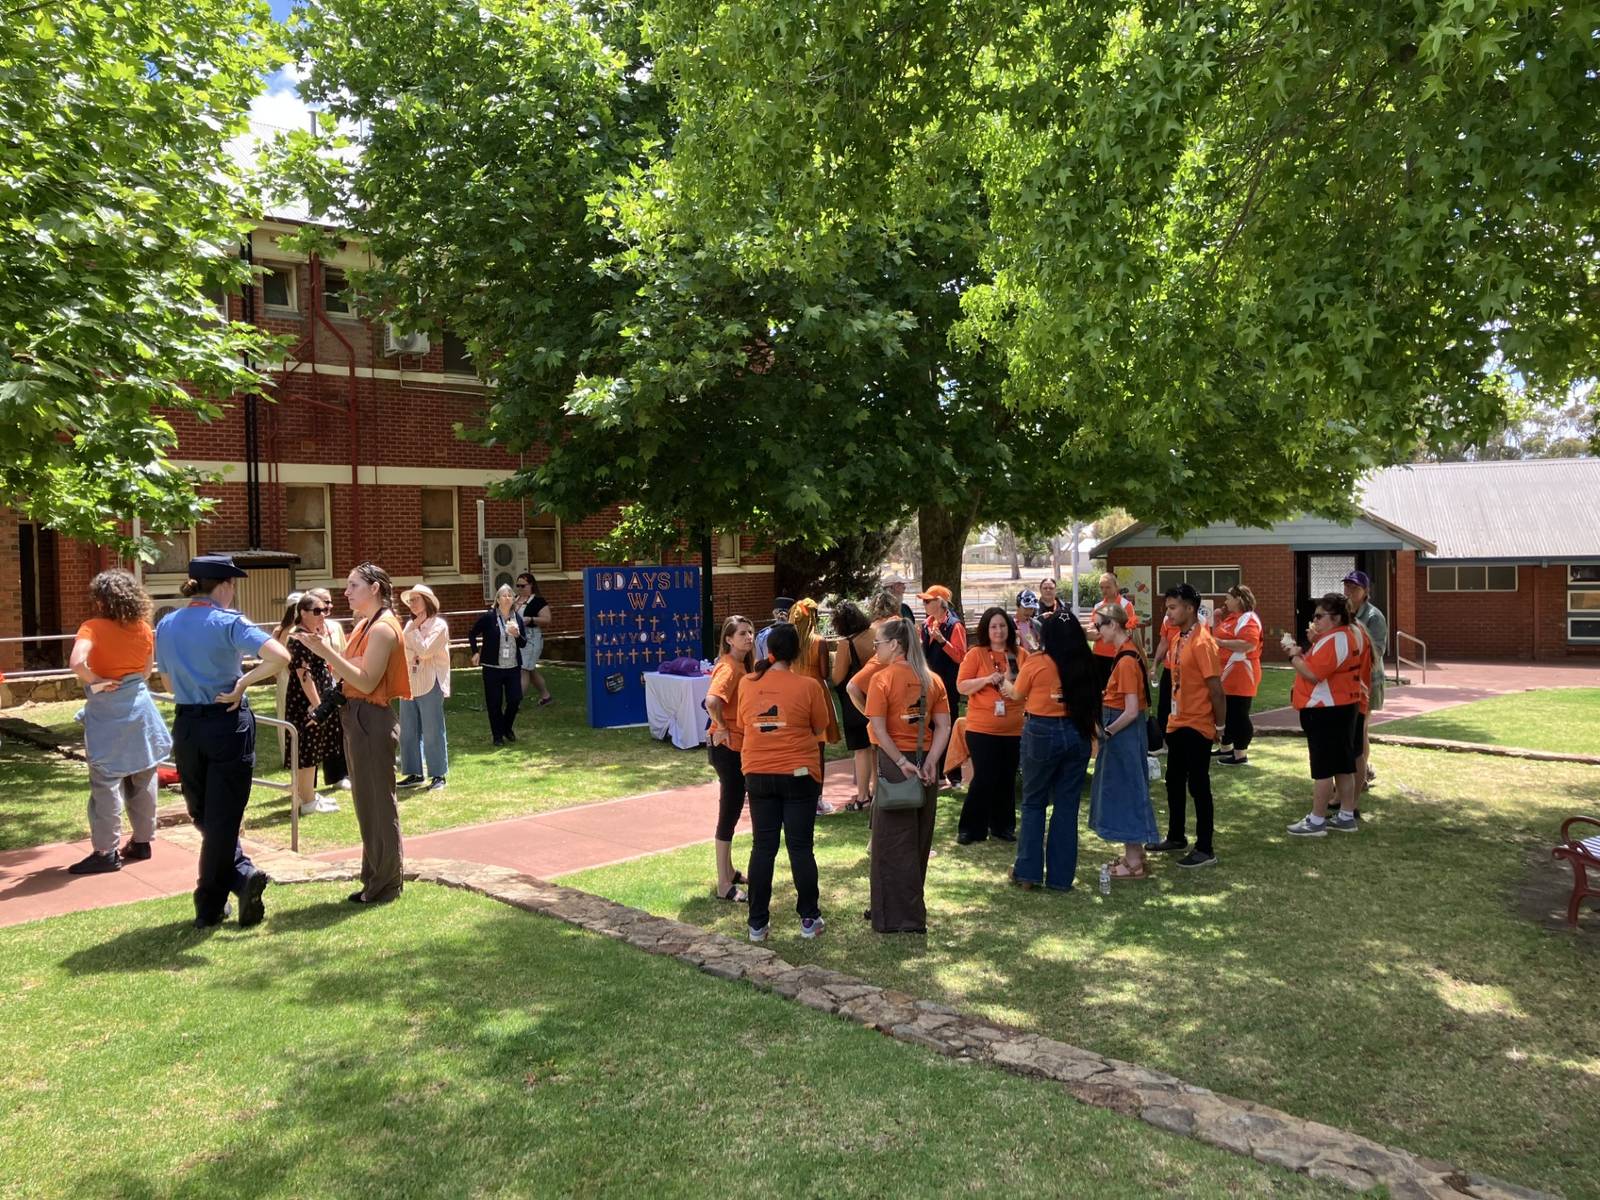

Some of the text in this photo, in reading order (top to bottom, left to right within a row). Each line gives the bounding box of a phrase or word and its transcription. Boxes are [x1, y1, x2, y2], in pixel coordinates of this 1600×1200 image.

[674, 571, 694, 589] IN
[627, 591, 667, 610] WA
[595, 633, 626, 646] PLAY
